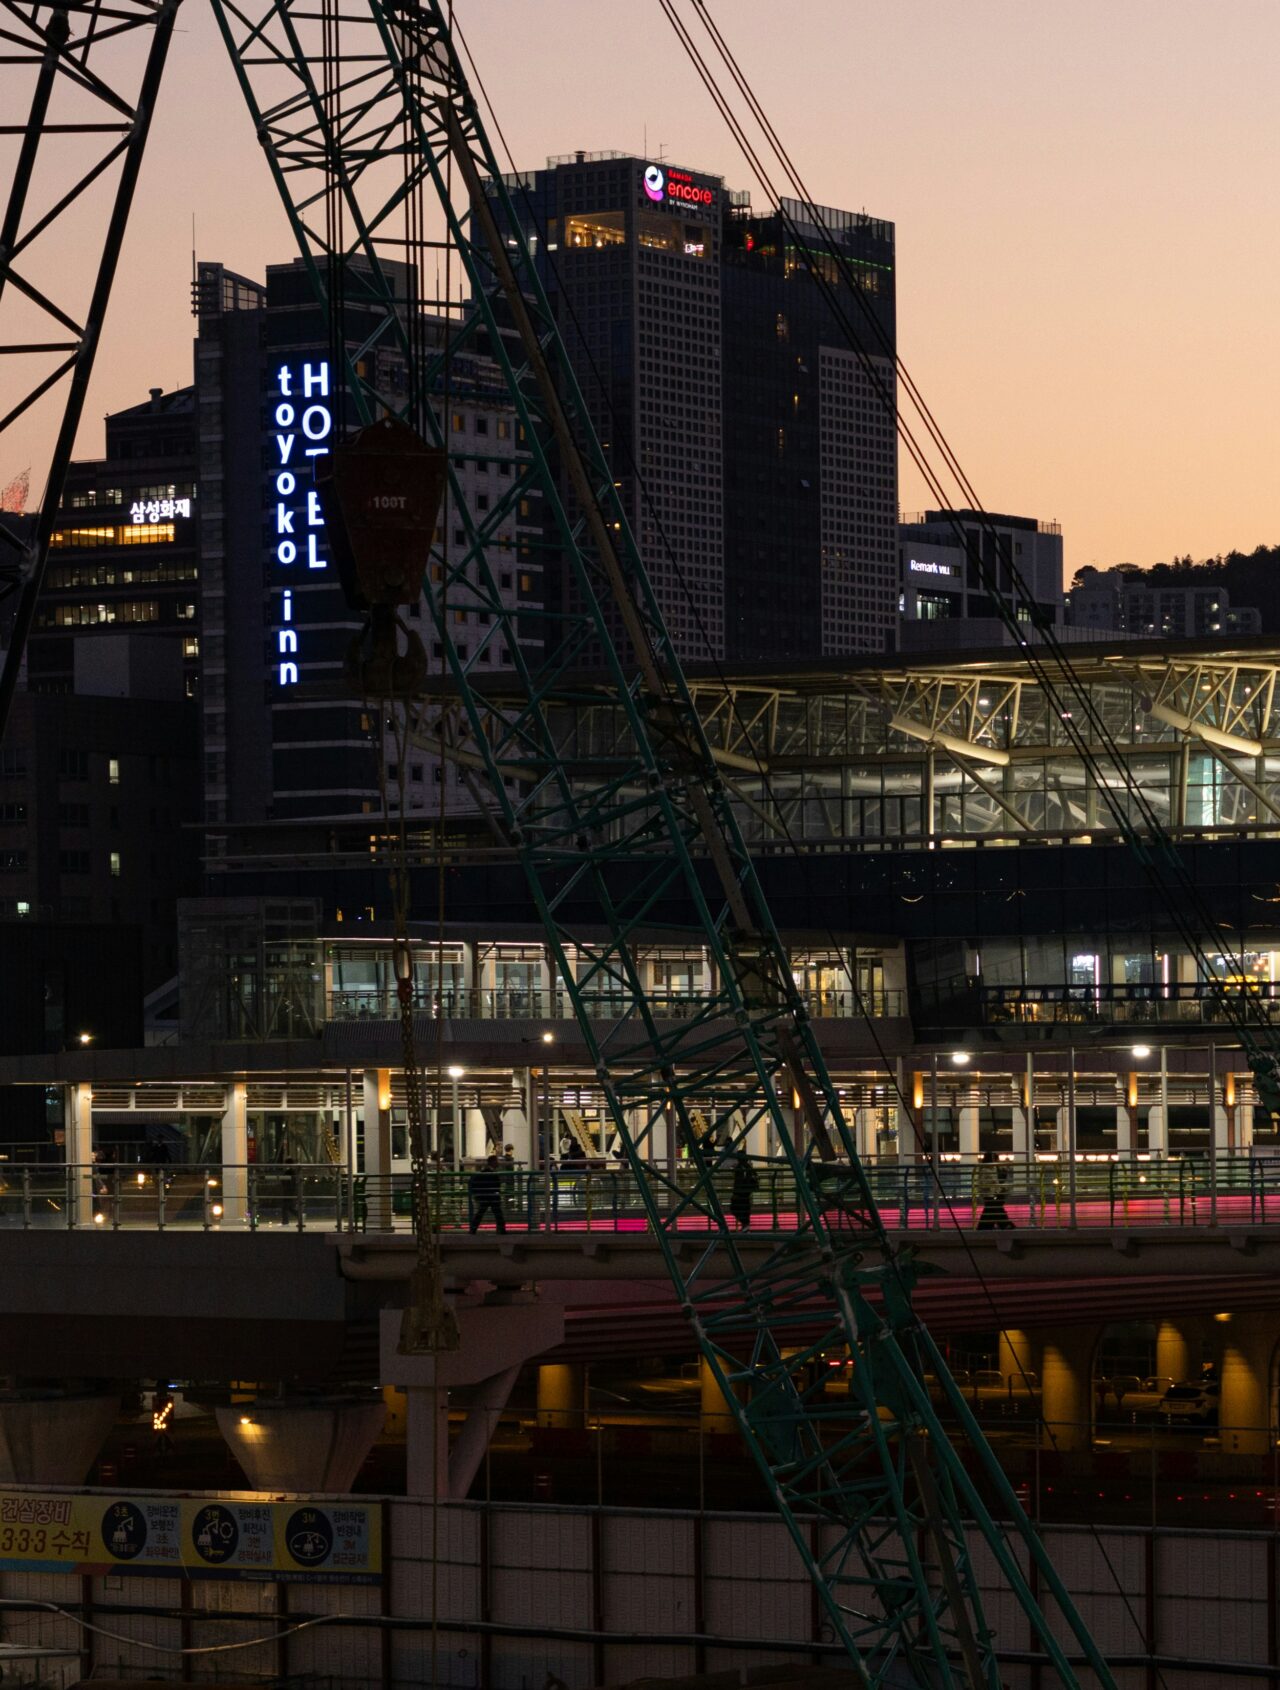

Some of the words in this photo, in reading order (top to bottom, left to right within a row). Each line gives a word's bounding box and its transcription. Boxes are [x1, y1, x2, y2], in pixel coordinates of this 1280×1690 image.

[667, 182, 713, 205] encore
[275, 365, 297, 564] toyoko
[130, 498, 191, 523] 삼성화재
[372, 496, 407, 509] 100T
[910, 559, 938, 574] Remark
[278, 589, 298, 686] inn
[2, 1498, 72, 1526] 건설장비
[51, 1530, 91, 1557] 수칙
